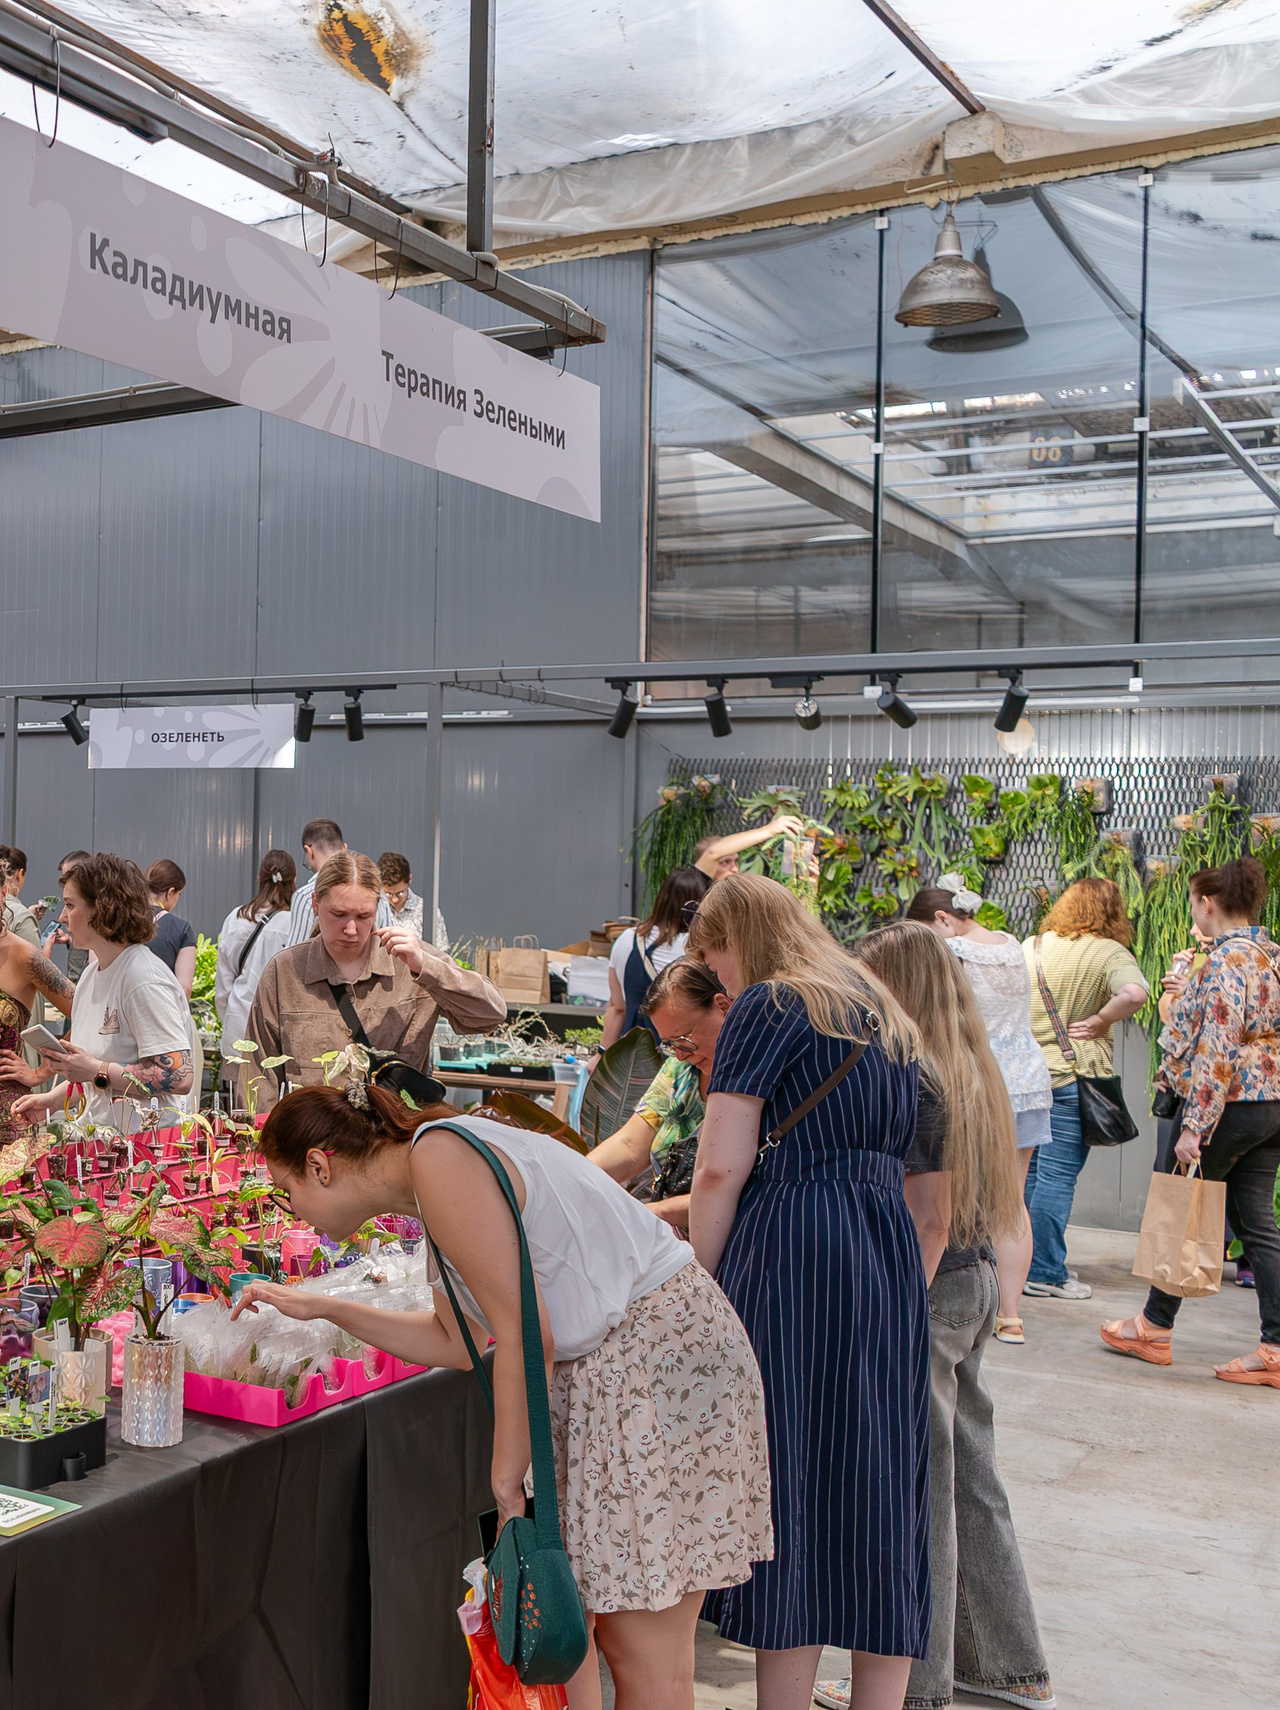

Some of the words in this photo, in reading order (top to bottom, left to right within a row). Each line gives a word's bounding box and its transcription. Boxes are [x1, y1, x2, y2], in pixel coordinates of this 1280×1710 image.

[89, 231, 293, 344] Каладиумная
[381, 349, 467, 413] Терапия
[473, 387, 566, 450] Зелеными
[150, 731, 225, 745] ОЗЕЛЕНЕТЬ
